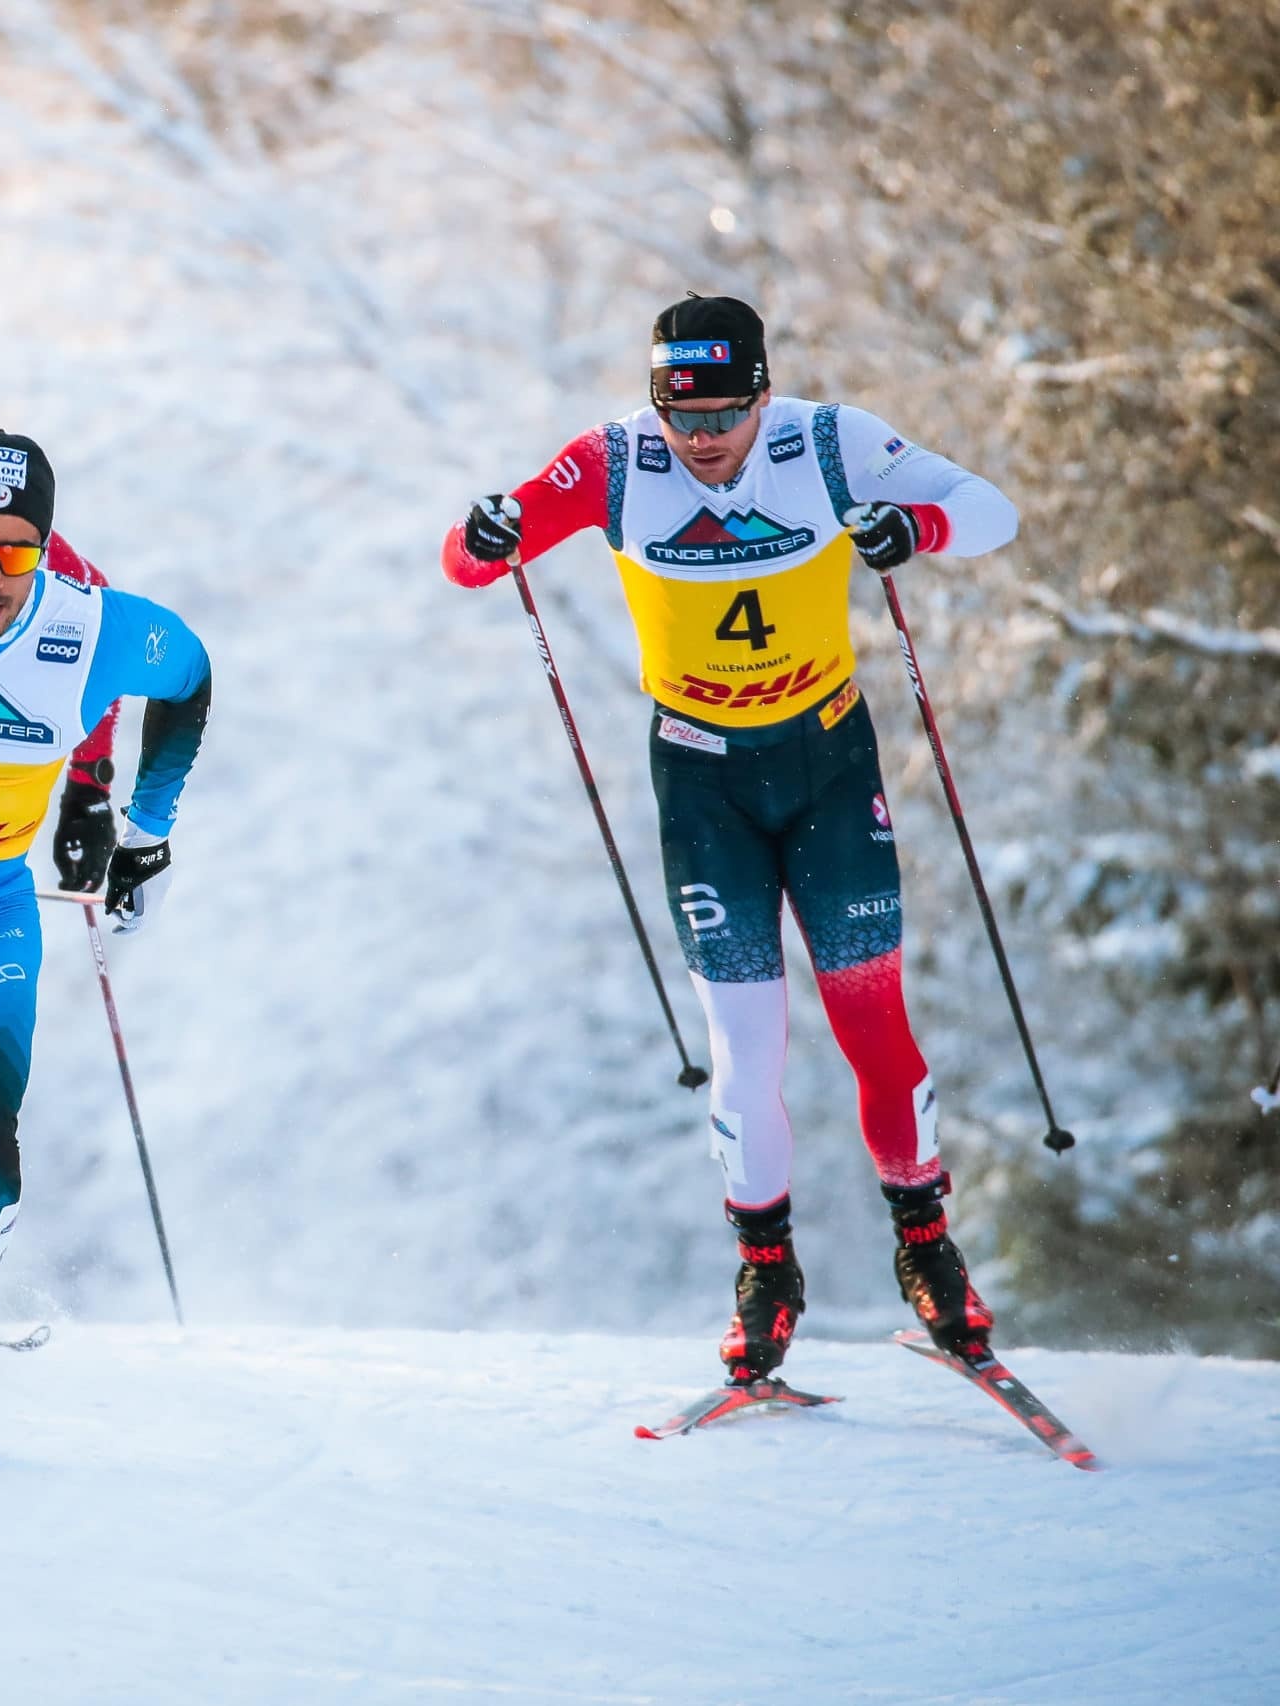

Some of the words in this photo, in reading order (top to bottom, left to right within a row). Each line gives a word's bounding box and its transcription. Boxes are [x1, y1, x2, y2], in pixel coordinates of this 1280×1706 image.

[771, 439, 802, 457] coop
[641, 457, 666, 468] coop
[651, 546, 714, 561] TINDE
[720, 532, 809, 559] HYTTER
[715, 588, 776, 651] 4
[39, 643, 79, 659] coop
[706, 652, 792, 673] LILLEHAMMER
[680, 657, 817, 709] DHL
[140, 848, 164, 866] Swix
